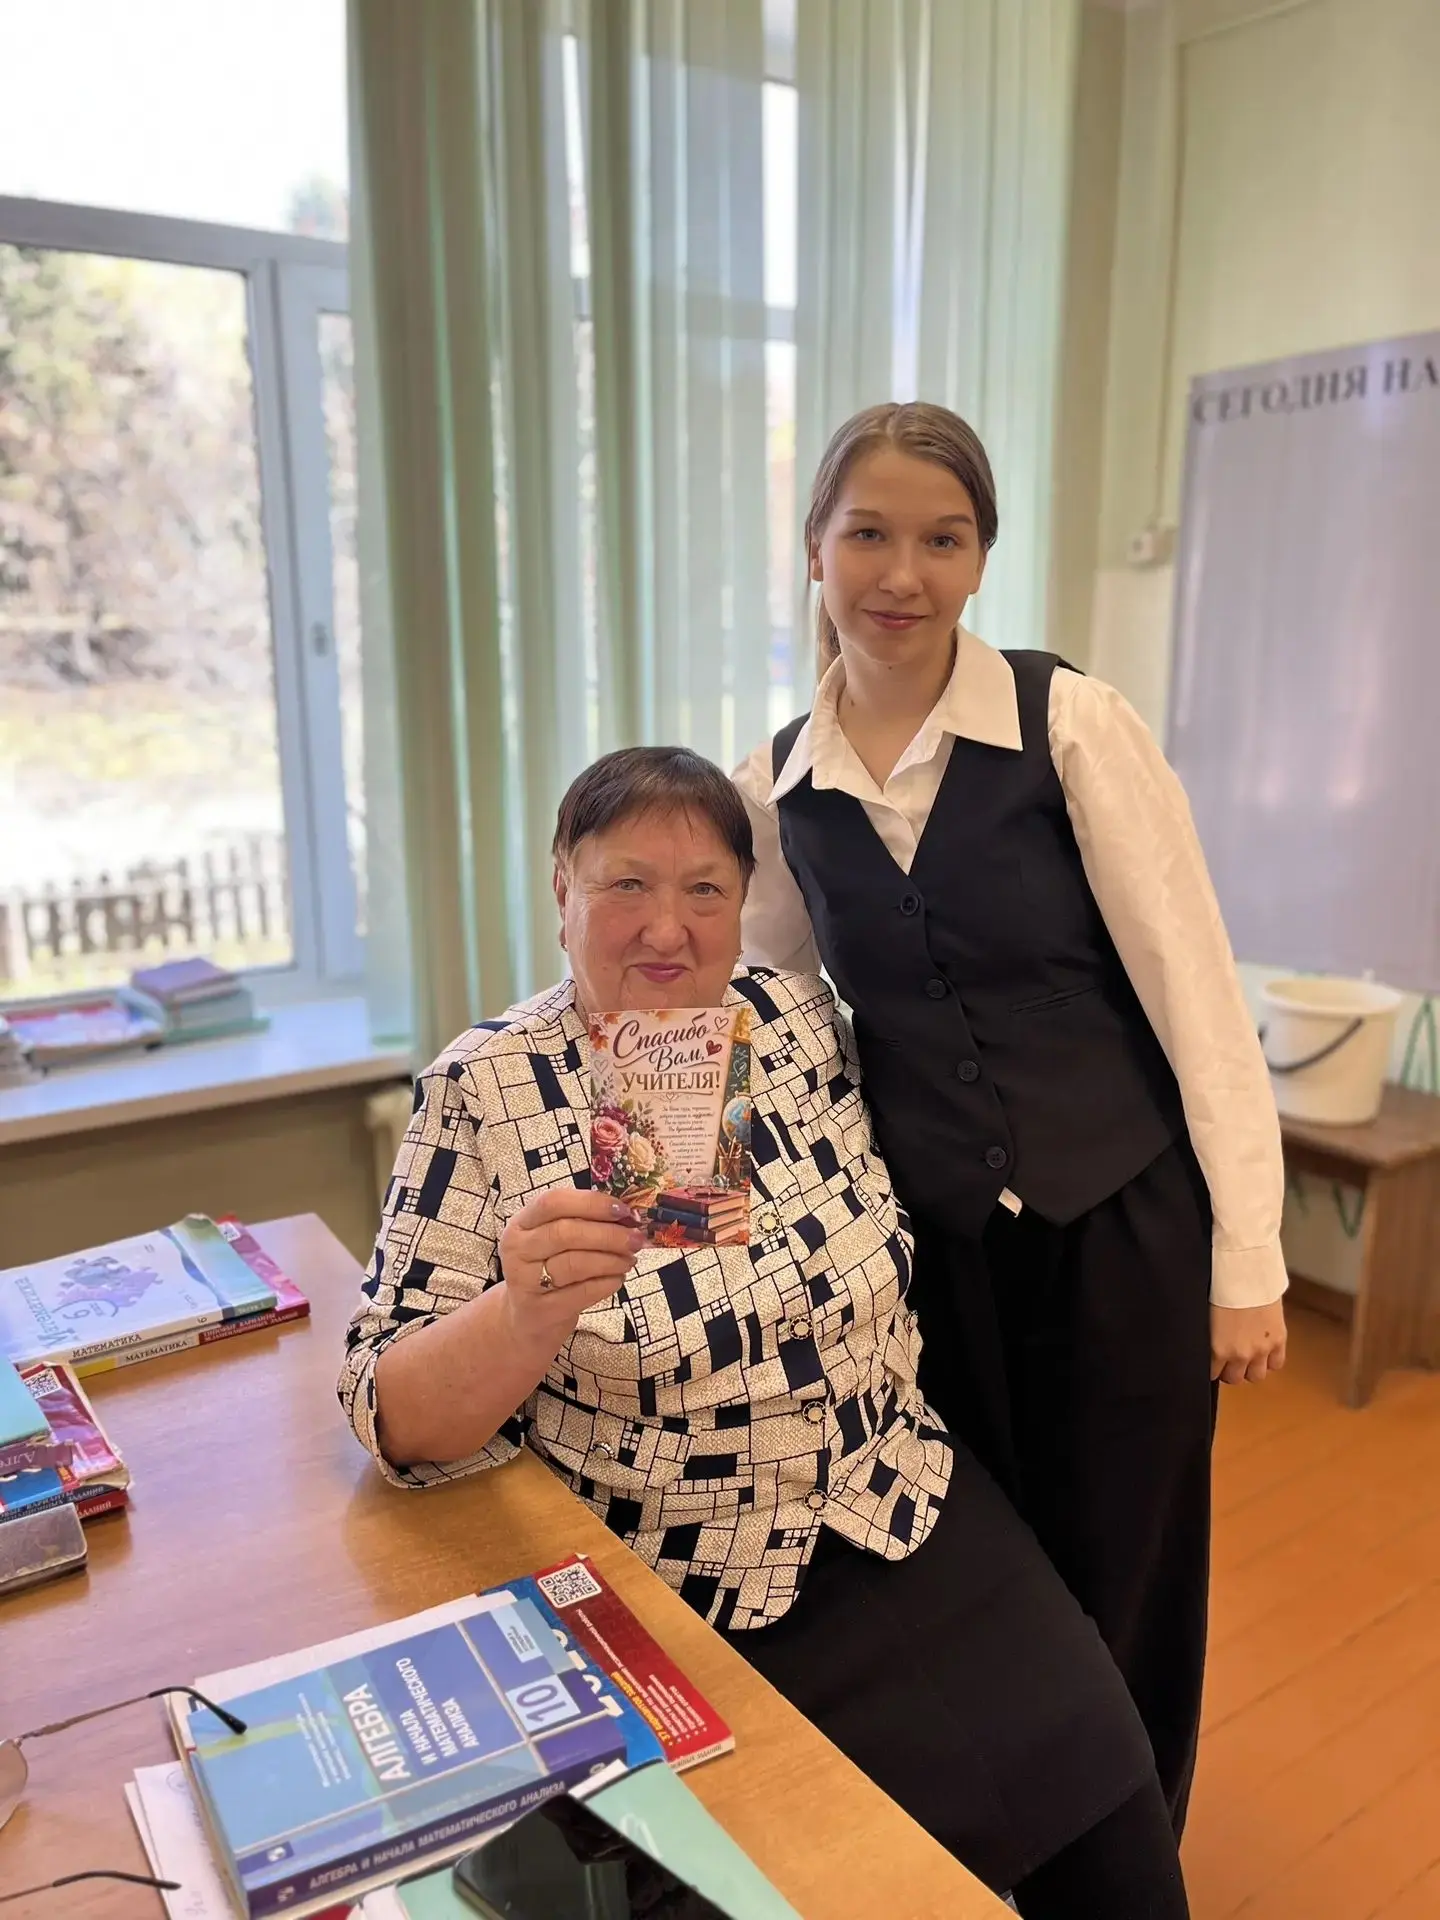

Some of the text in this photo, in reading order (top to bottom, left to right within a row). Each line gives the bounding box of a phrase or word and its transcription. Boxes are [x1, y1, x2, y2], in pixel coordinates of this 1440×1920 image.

[1192, 366, 1368, 425] СЕГОДНЯ
[613, 1011, 710, 1059] Спасибо
[648, 1045, 705, 1073] Вам,
[620, 1070, 720, 1093] УЧИТЕЛЯ!
[72, 1333, 142, 1358] МАТЕМАТИКА
[125, 1340, 188, 1361] МАТЕМАТИКА
[396, 1657, 459, 1757] МАТЕМАТИЧЕСКОГО
[442, 1697, 480, 1748] АНАЛИЗА
[516, 1684, 567, 1722] 10
[343, 1683, 411, 1780] АЛГЕБРА
[400, 1708, 438, 1765] И НАЧАЛА
[658, 1730, 671, 1742] 37
[309, 1780, 565, 1889] АЛГЕБРА И НАЧАЛА МАТЕМАТИЧЕСКОГО АНАЛИЗА
